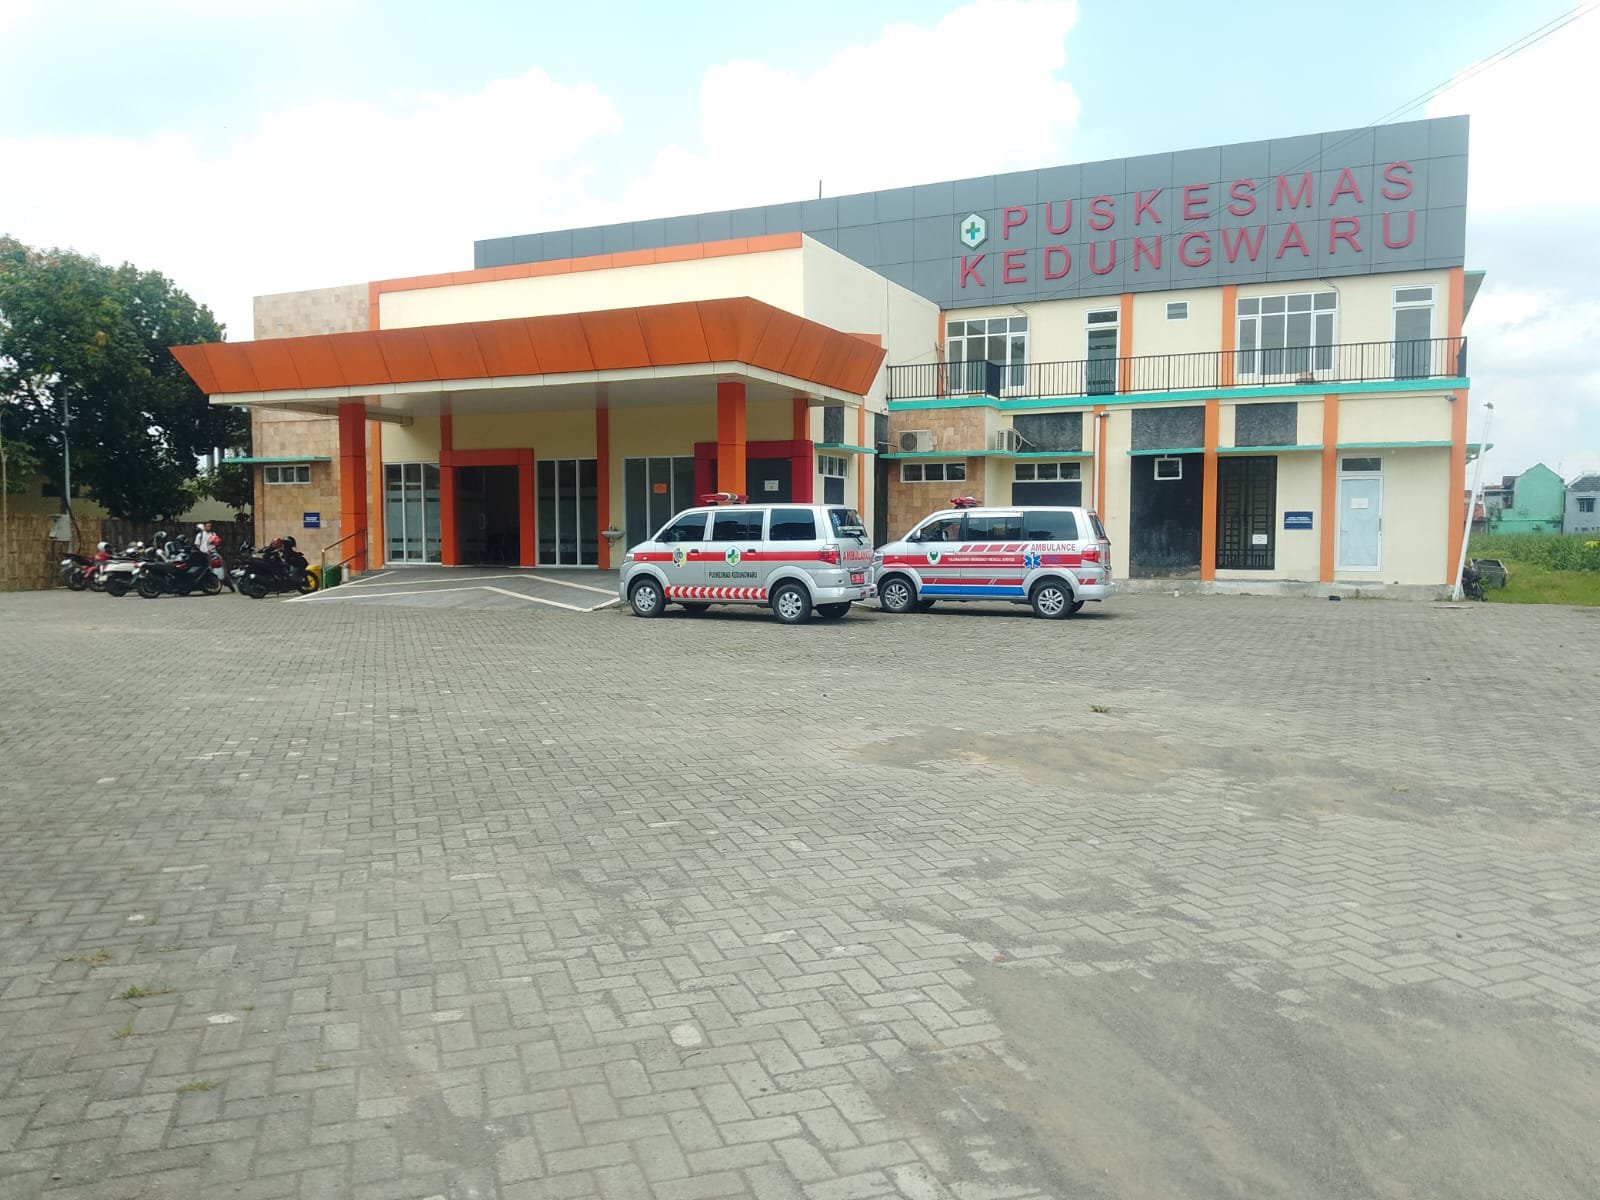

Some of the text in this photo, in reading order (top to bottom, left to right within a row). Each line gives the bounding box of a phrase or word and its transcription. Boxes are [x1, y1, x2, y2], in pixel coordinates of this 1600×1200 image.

[1003, 162, 1415, 241] PUSKESMAS
[960, 211, 1416, 289] KEDUNGWARU
[1030, 543, 1077, 552] AMBULANCE
